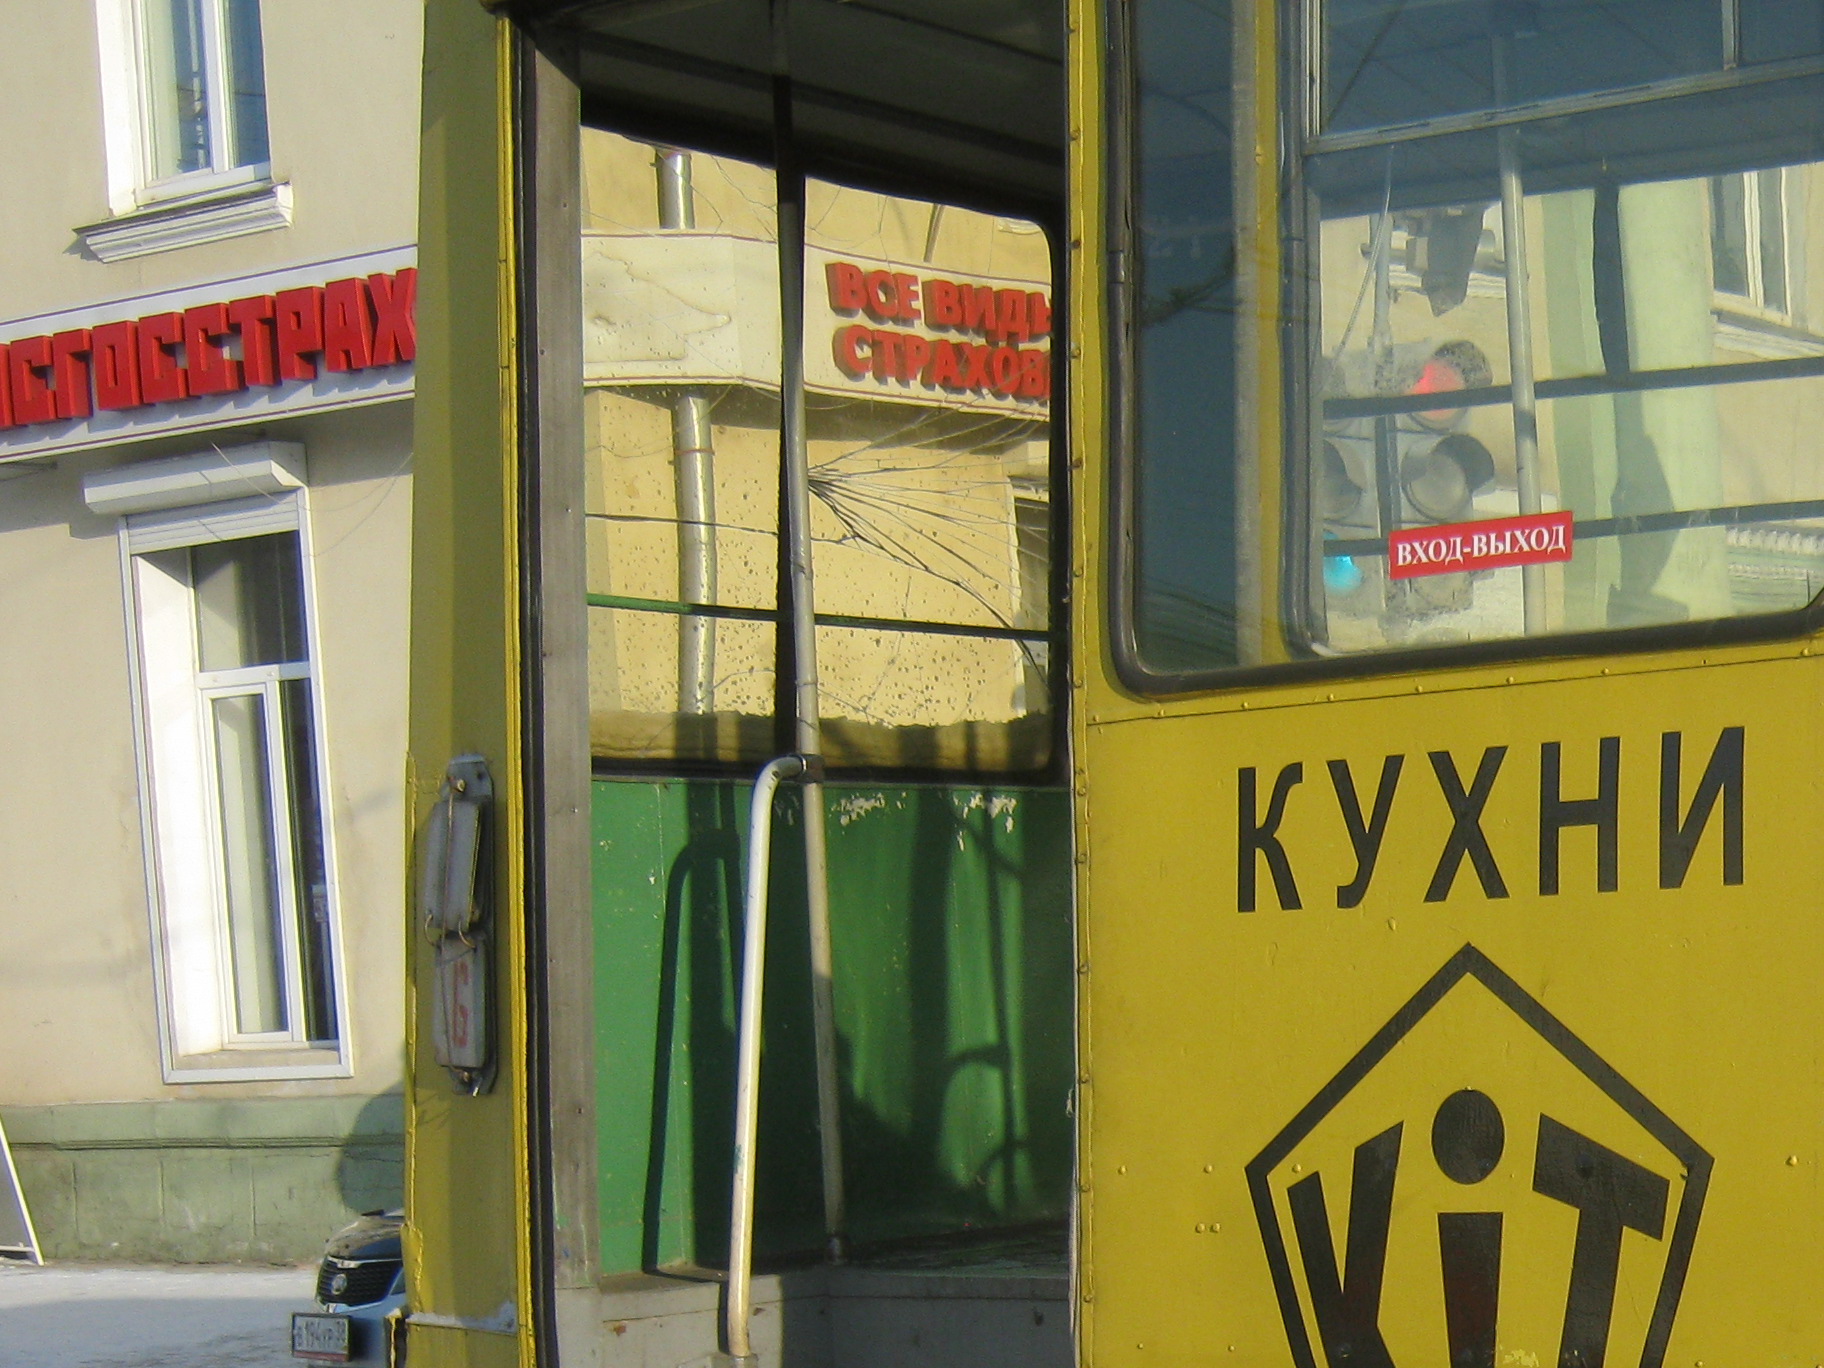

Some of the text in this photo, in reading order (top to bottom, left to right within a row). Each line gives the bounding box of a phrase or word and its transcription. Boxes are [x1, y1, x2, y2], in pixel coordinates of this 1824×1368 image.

[826, 262, 922, 322] ВСЕ
[0, 268, 417, 429] СГОССТРАХ
[833, 325, 1049, 400] СТРАХОВ
[1396, 524, 1567, 567] ВХОД-ВЫХОД
[1237, 726, 1745, 913] КУХНИ
